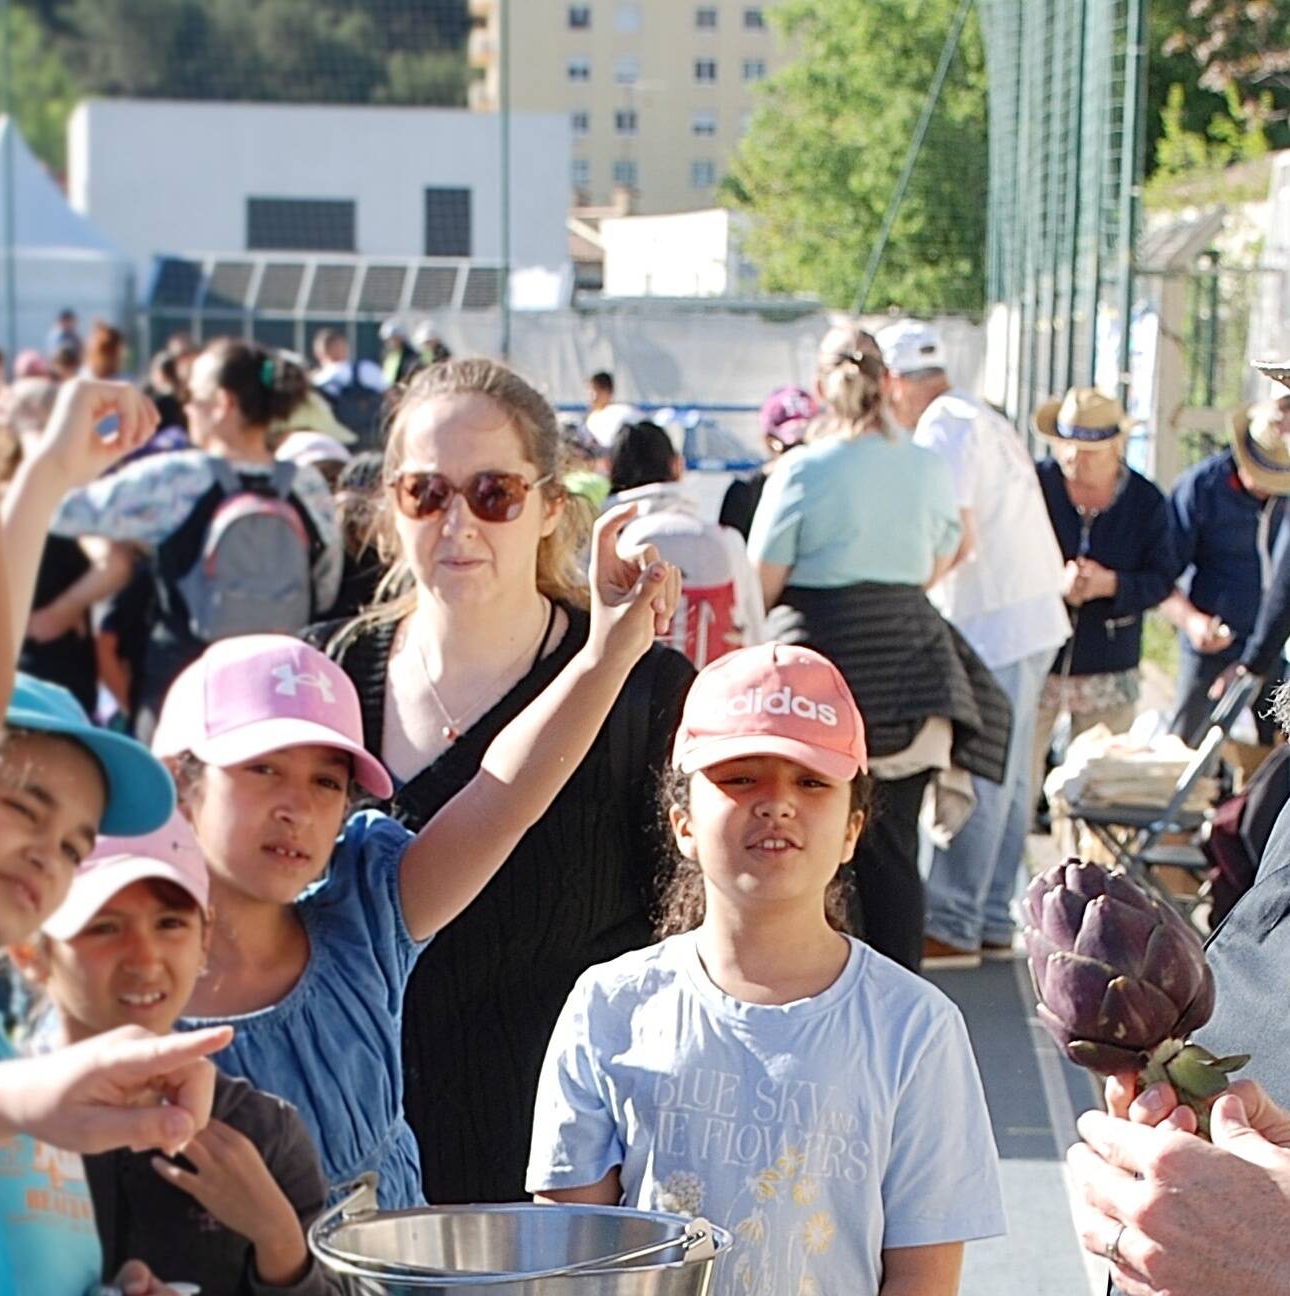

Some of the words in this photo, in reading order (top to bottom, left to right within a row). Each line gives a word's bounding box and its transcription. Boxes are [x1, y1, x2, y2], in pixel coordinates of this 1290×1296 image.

[713, 686, 838, 727] didas
[654, 1067, 741, 1118] BLUE
[700, 1117, 870, 1183] FLOWERS
